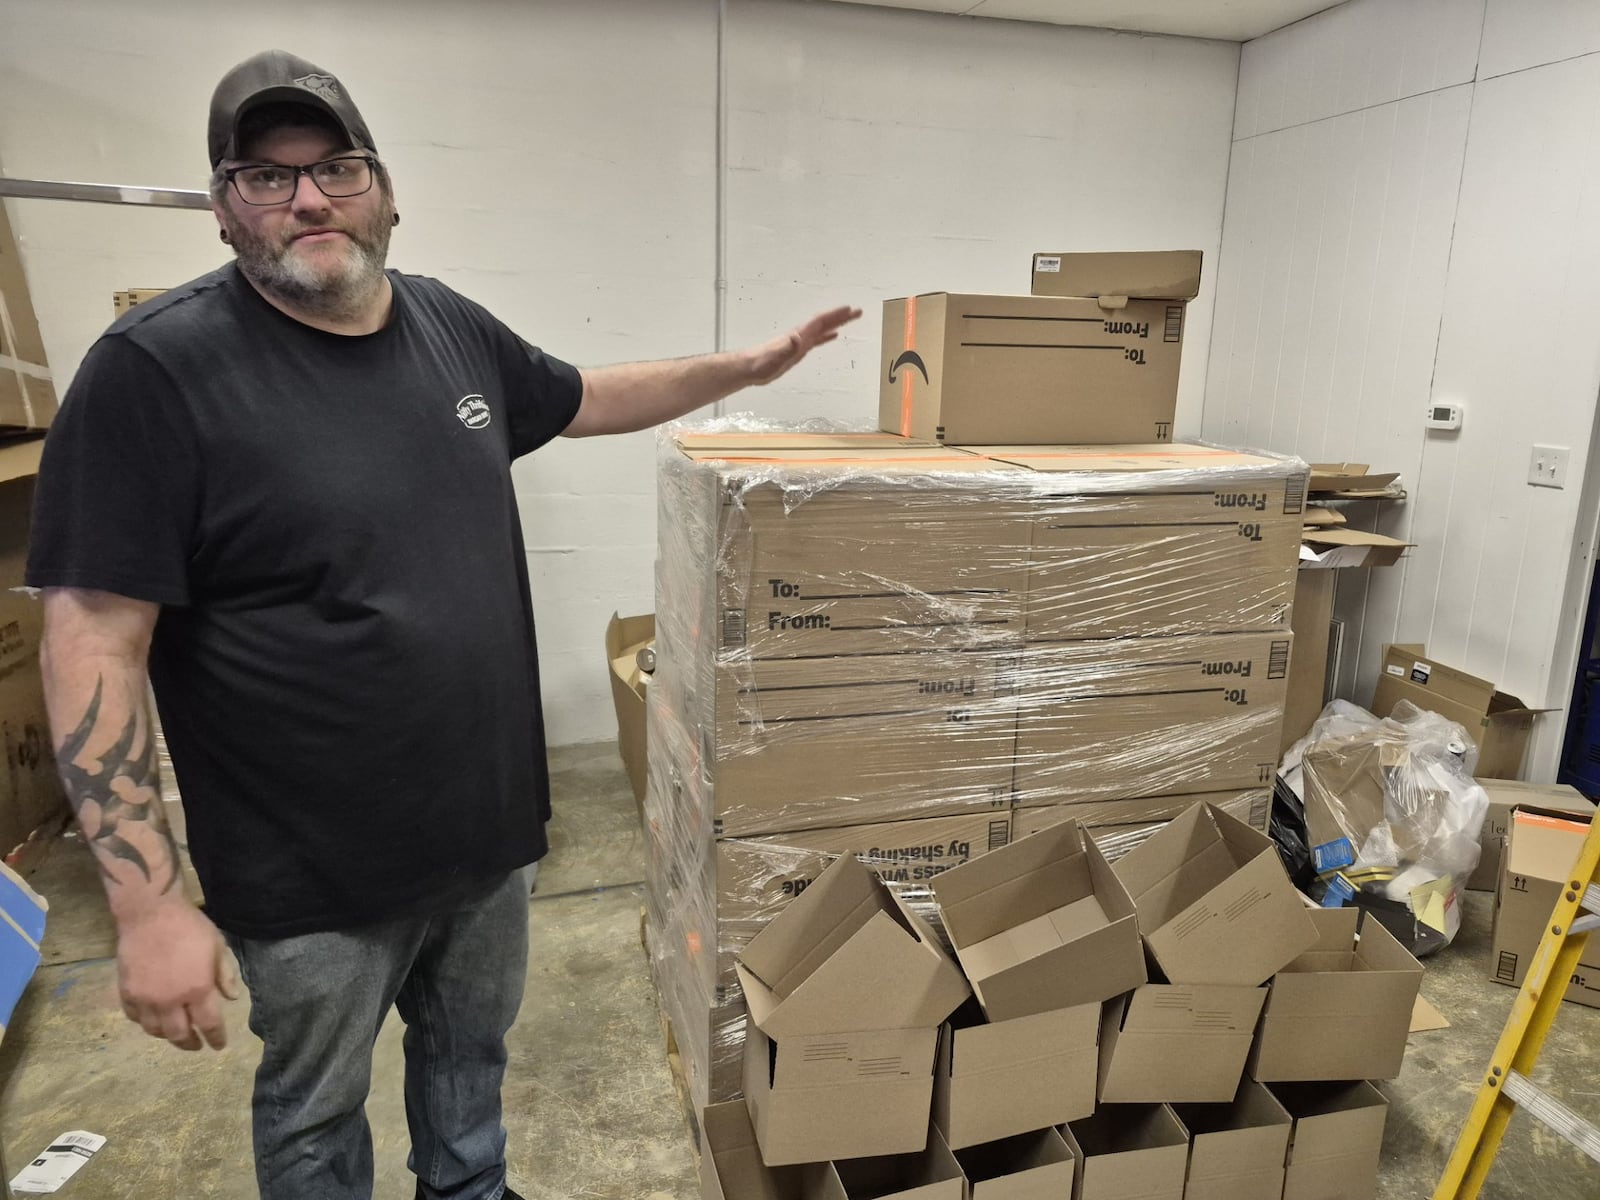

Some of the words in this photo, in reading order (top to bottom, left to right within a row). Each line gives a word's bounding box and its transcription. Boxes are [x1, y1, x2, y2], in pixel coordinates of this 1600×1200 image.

[1104, 320, 1149, 338] From:
[1125, 349, 1146, 365] To:
[1214, 493, 1267, 510] From:
[1238, 524, 1263, 541] To:
[768, 579, 800, 598] To:
[768, 612, 831, 630] From:
[1201, 661, 1252, 677] From:
[918, 678, 975, 696] From:
[1225, 689, 1248, 705] To:
[947, 840, 970, 859] by
